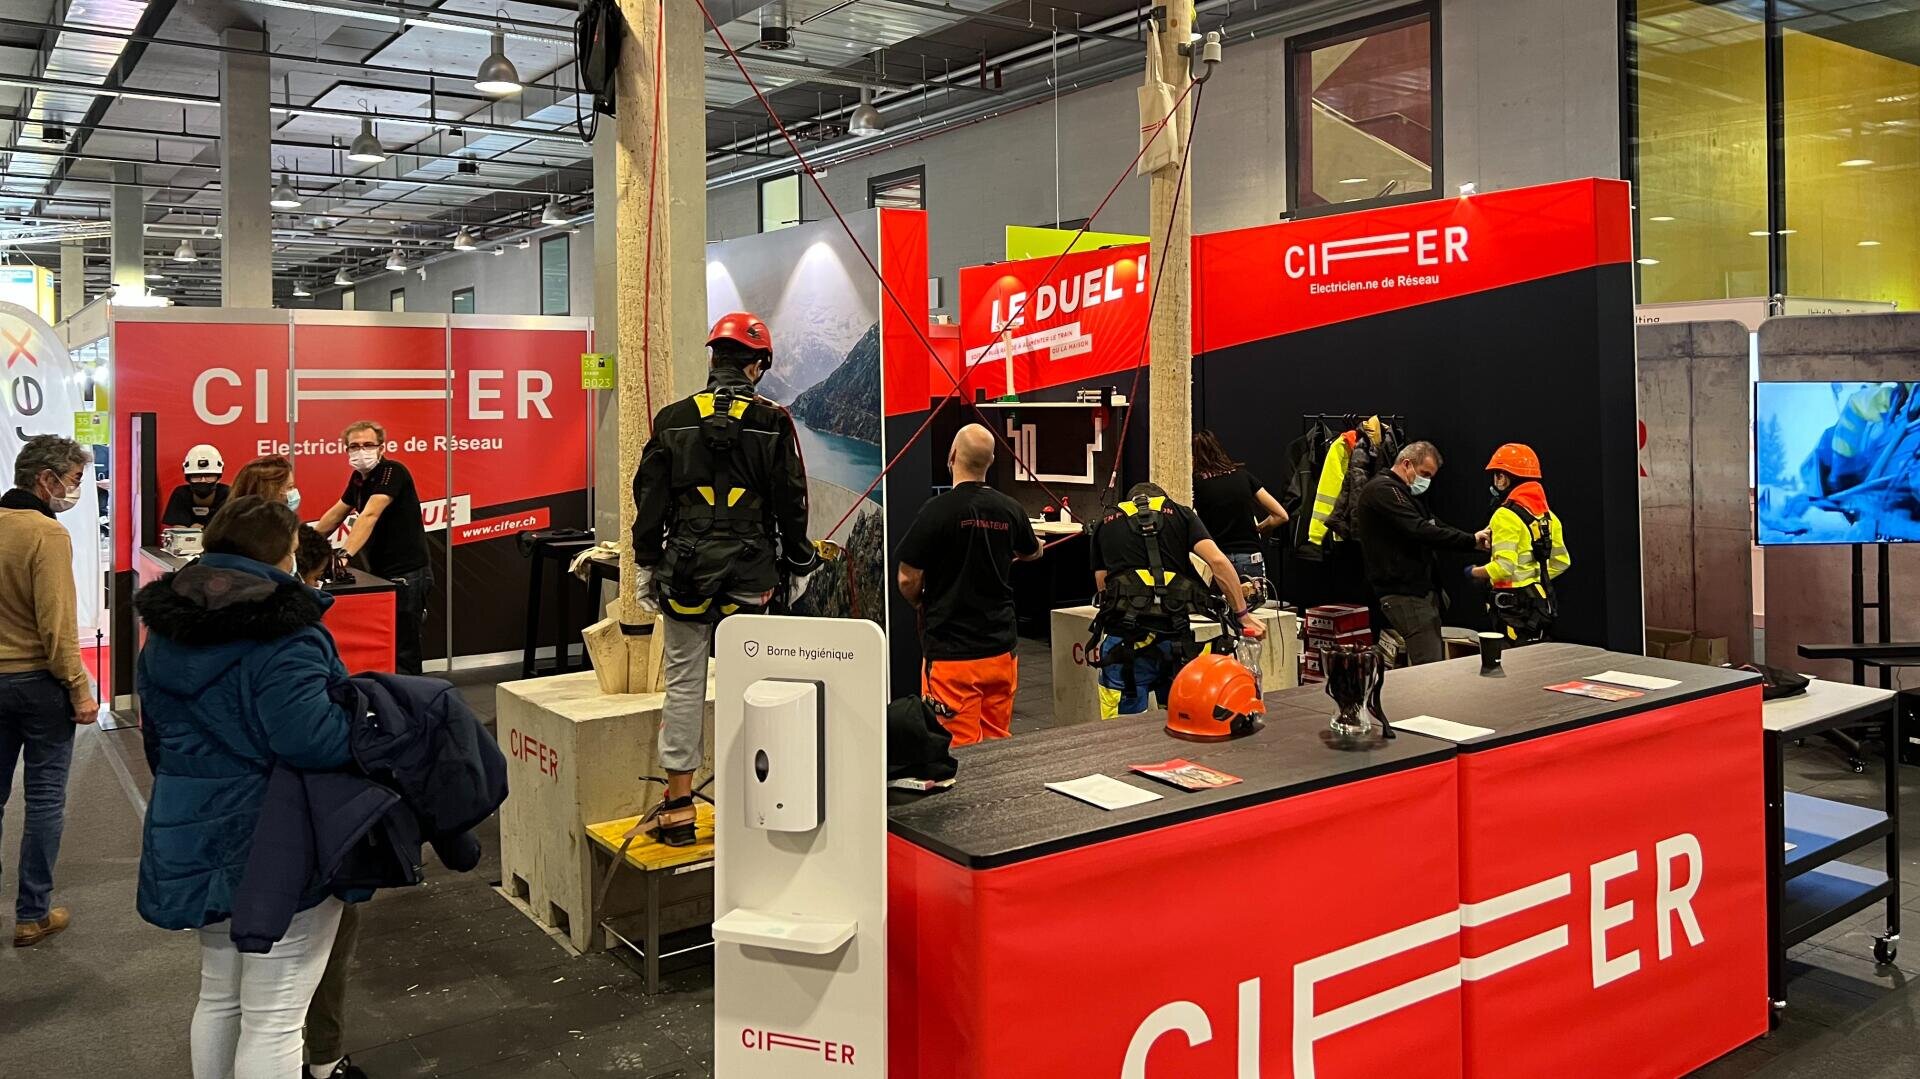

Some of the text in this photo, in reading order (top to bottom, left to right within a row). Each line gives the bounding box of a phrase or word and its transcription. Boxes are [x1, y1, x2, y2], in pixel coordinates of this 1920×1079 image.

[1284, 226, 1469, 279] CIFER
[991, 254, 1147, 333] LE DUEL !
[1309, 274, 1440, 295] Electricien.ne de Réseau
[1068, 340, 1089, 351] MAISON
[192, 368, 553, 425] CIFER
[404, 436, 428, 452] de
[433, 435, 503, 452] Réseau
[462, 516, 537, 538] www.cifer.ch
[767, 645, 854, 661] Borne hygiénique
[510, 728, 559, 785] CIFER
[741, 1028, 855, 1065] CIFER
